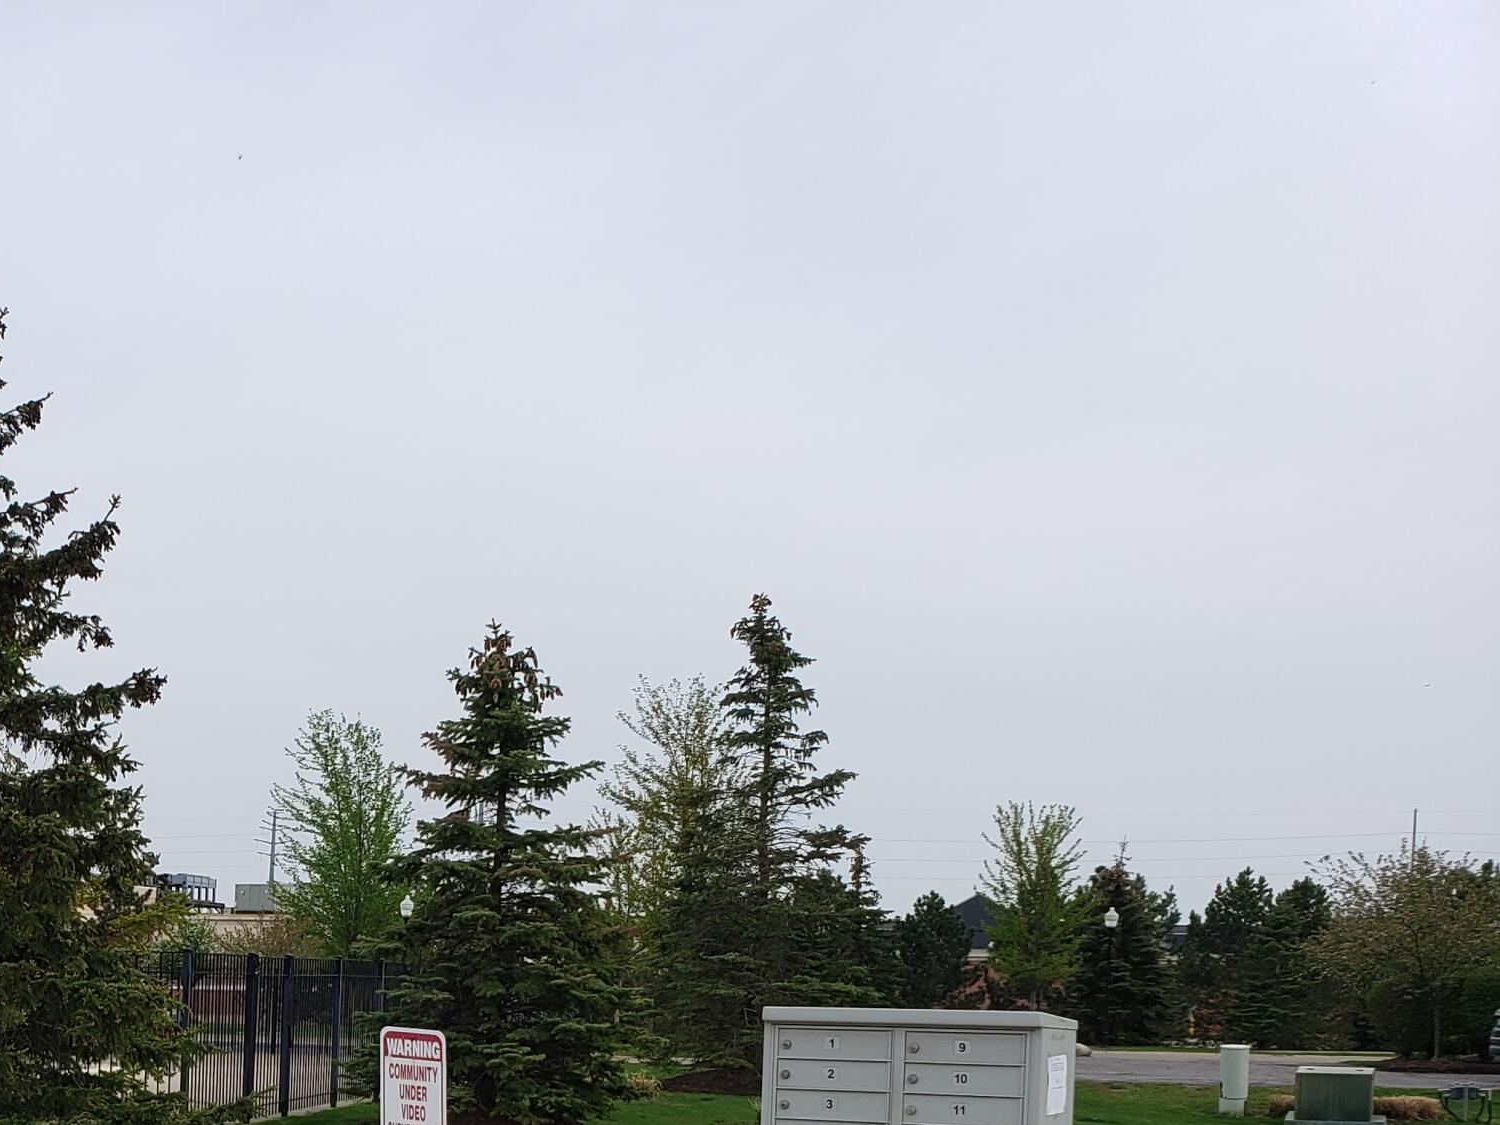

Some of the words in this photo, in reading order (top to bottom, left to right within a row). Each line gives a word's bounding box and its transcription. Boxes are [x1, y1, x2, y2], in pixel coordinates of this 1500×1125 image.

[386, 1037, 441, 1059] WARNING
[828, 1038, 835, 1049] 1
[958, 1042, 966, 1053] 9
[388, 1063, 438, 1083] COMMUNITY
[827, 1068, 835, 1079] 2
[954, 1073, 968, 1084] 10
[399, 1084, 428, 1102] UNDER
[826, 1098, 833, 1109] 3
[400, 1103, 426, 1122] VIDEO
[953, 1105, 965, 1116] 11
